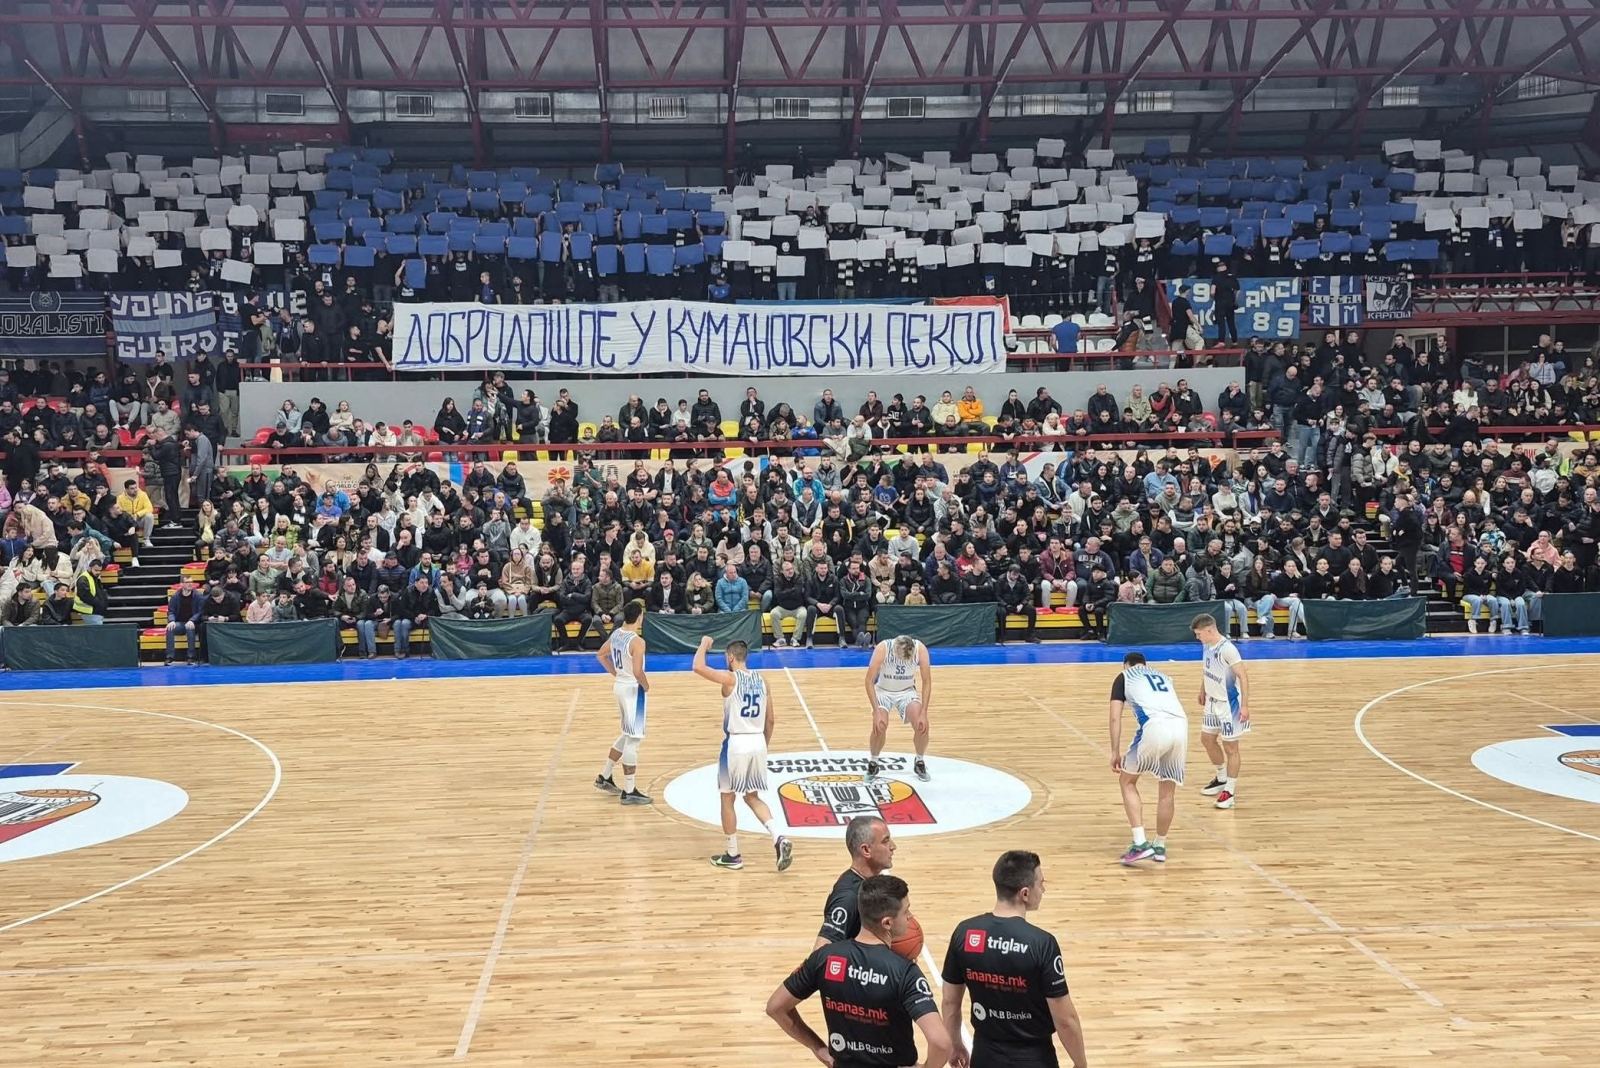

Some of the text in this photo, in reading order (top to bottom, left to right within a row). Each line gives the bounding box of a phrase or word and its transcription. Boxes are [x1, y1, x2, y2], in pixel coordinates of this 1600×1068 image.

[112, 290, 213, 317] YOUNG
[627, 310, 656, 366] У
[667, 306, 873, 370] КУМАНОВСКИ
[886, 310, 998, 369] ПЕКОЛ
[613, 648, 623, 670] 10
[895, 665, 906, 675] 55
[1143, 674, 1169, 692] 12
[740, 693, 760, 718] 25
[987, 936, 1028, 954] triglav
[848, 965, 888, 985] triglav
[988, 1008, 1032, 1020] NLB Banka
[846, 1041, 893, 1055] NLB Banka
